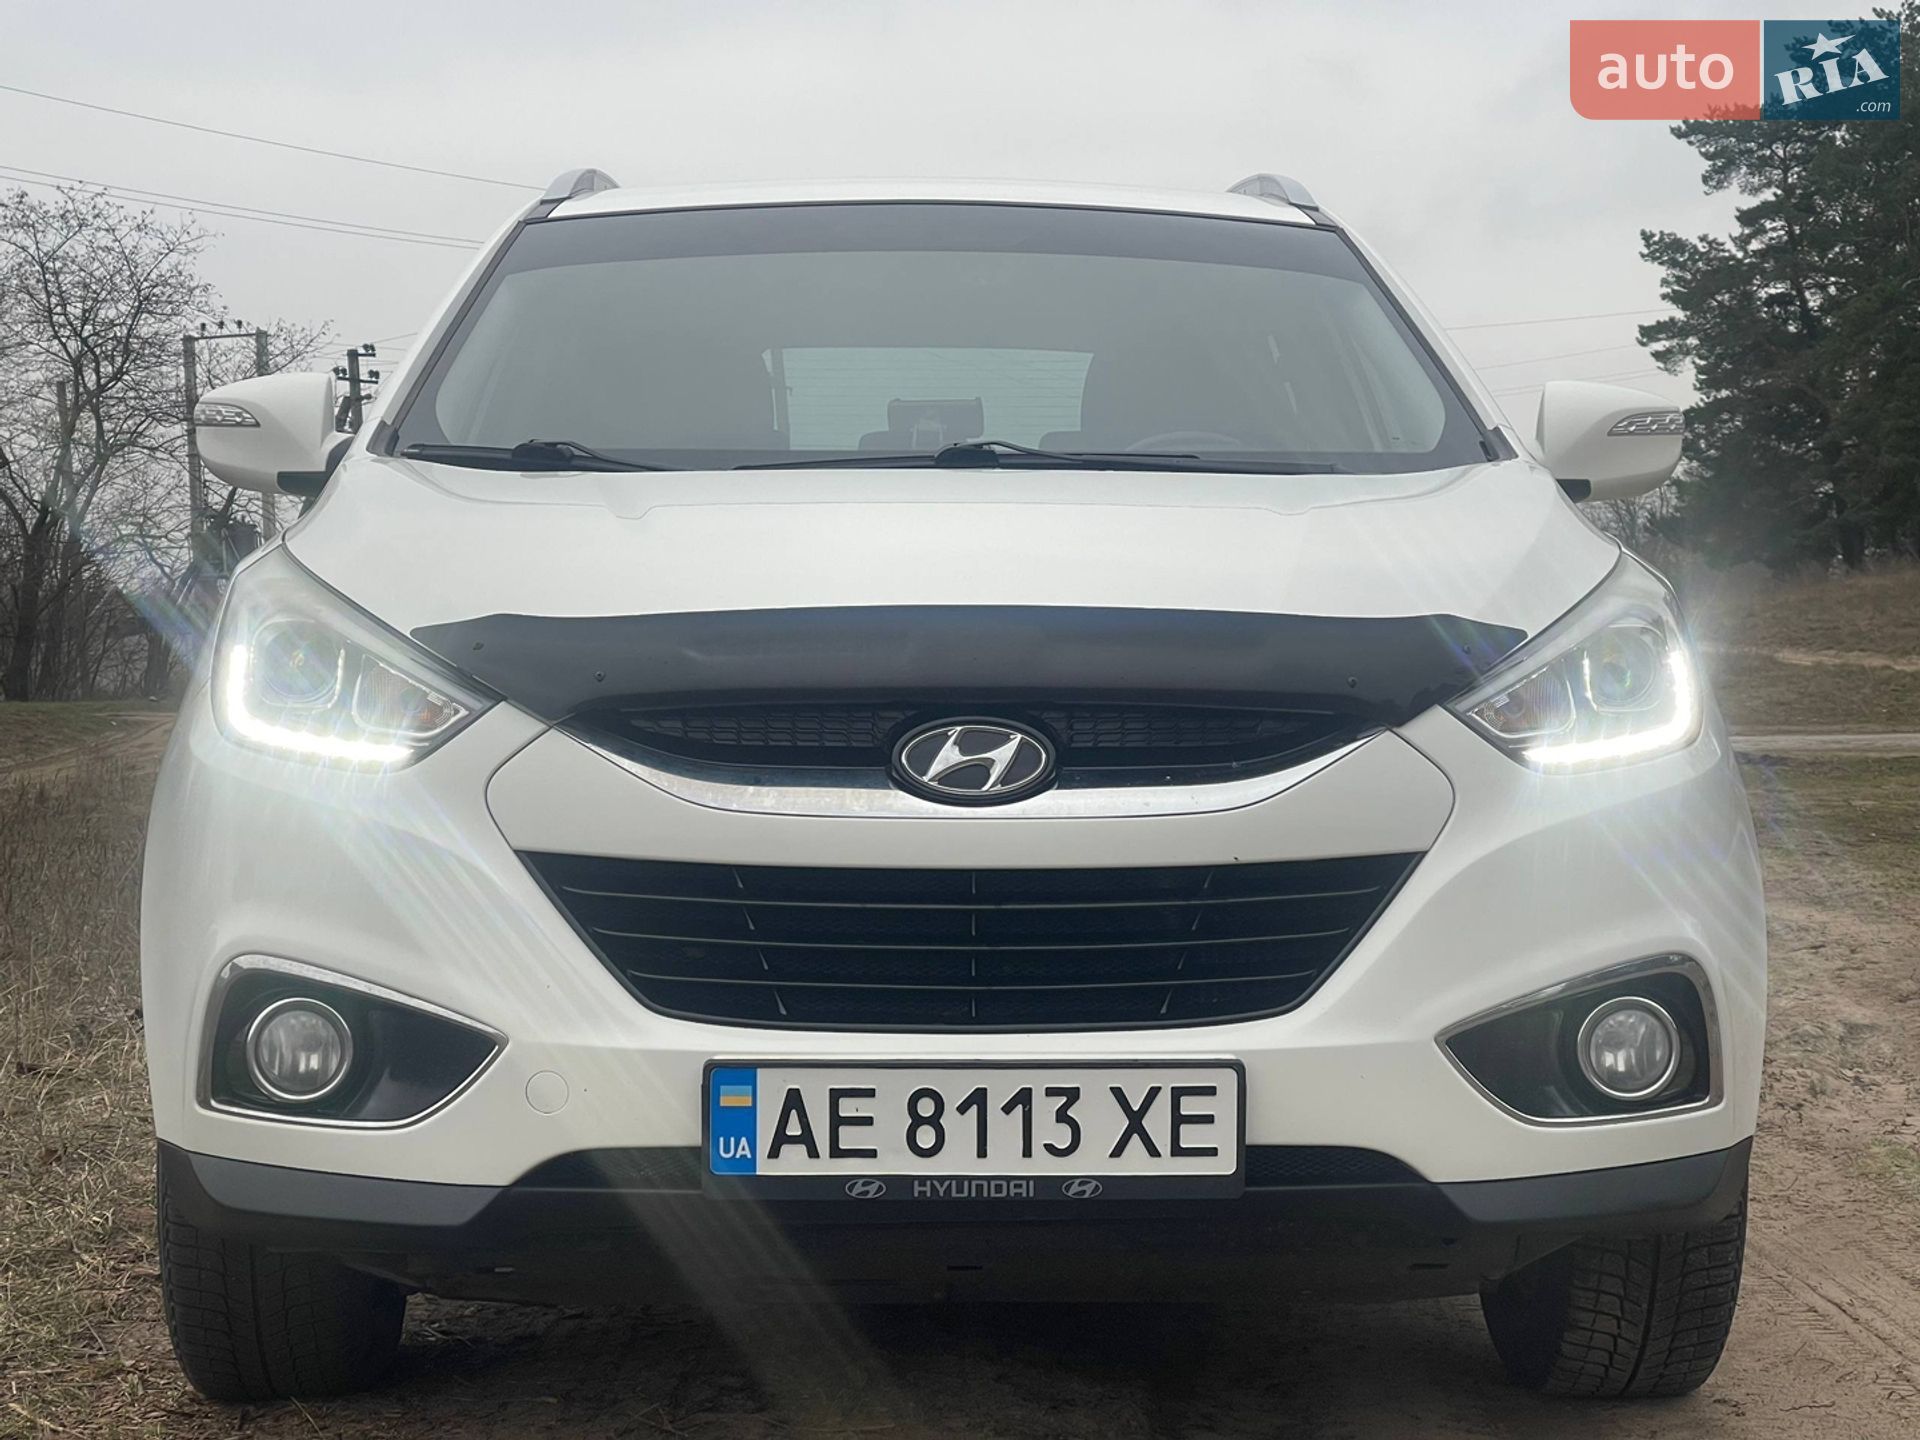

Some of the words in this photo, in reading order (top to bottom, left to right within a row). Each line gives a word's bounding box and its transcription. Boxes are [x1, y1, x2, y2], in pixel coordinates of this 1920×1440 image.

[766, 1086, 878, 1159] AE
[905, 1086, 1082, 1159] 8113
[1108, 1085, 1219, 1158] XE
[718, 1137, 752, 1159] UA
[913, 1180, 1035, 1199] HYUNDAI
